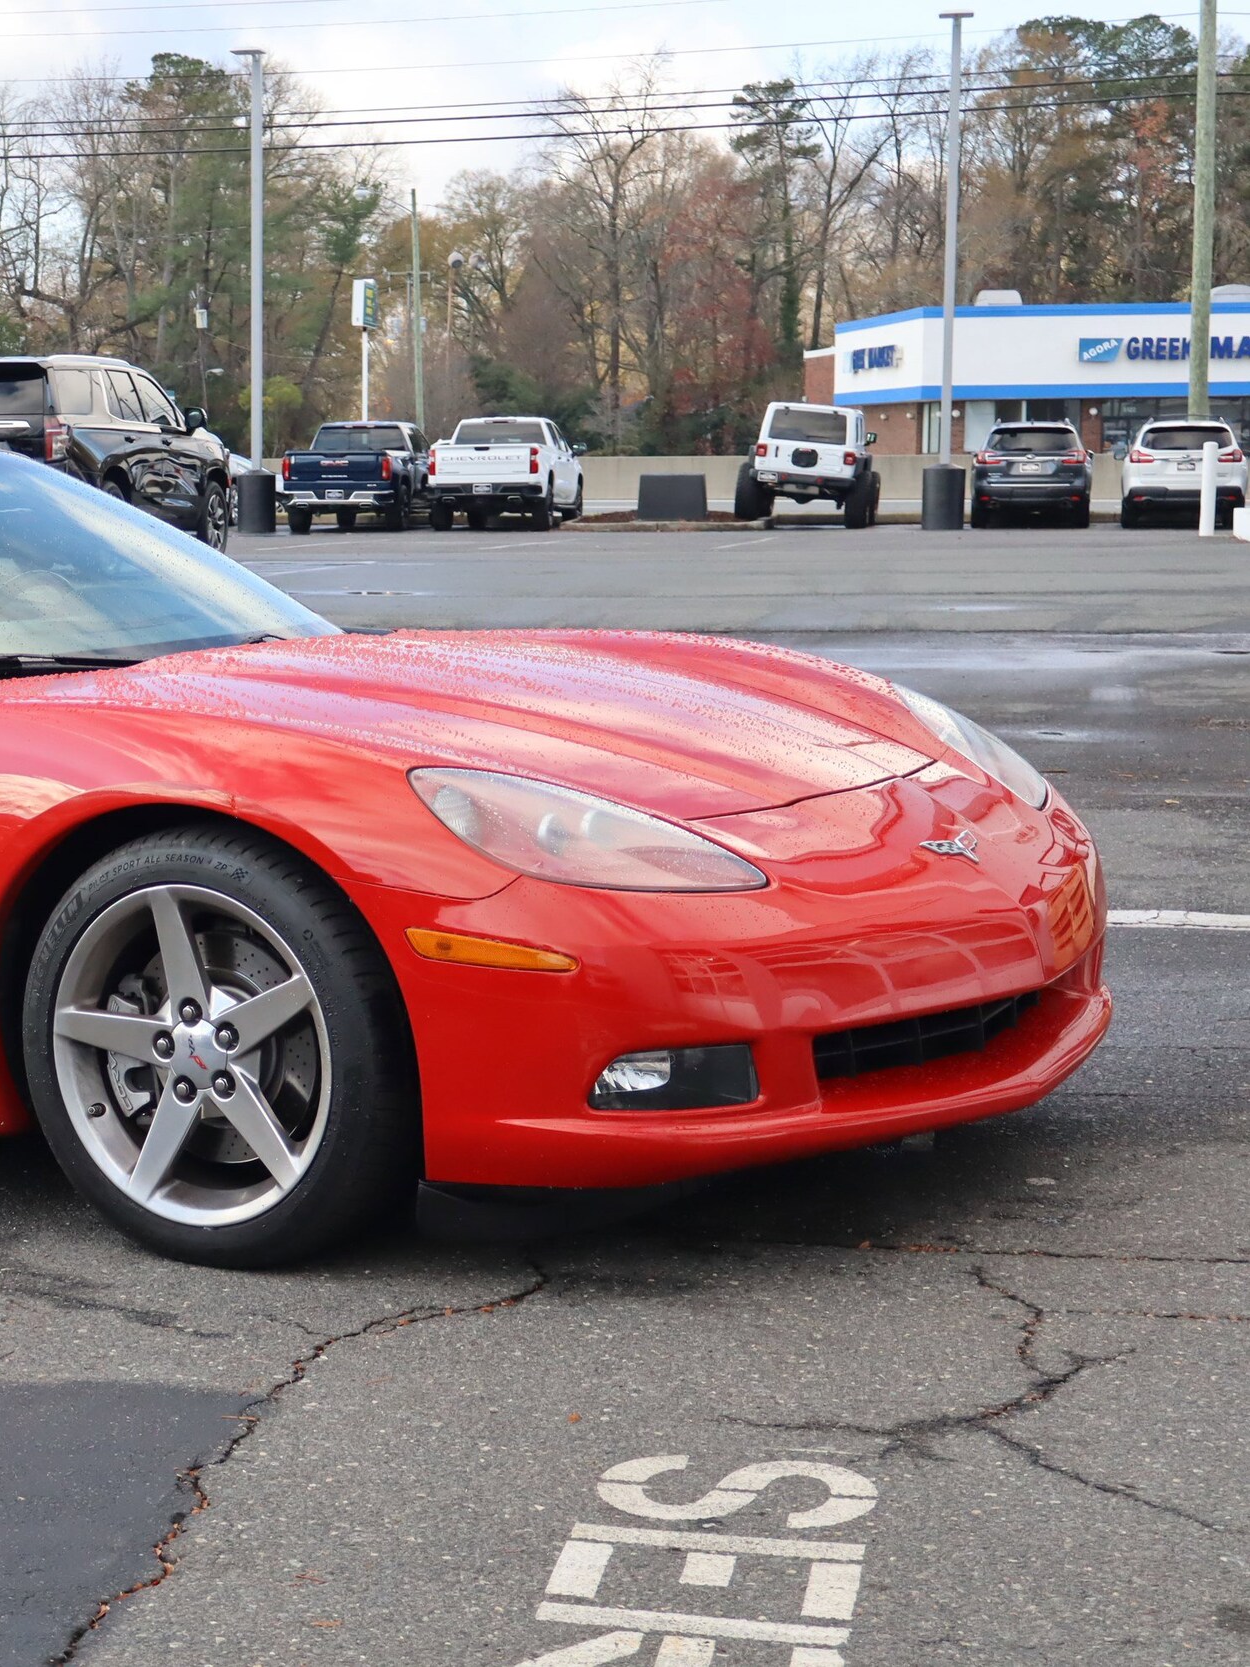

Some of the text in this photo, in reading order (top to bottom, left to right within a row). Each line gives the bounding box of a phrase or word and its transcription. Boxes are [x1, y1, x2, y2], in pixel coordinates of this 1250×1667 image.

[1082, 338, 1119, 361] AGORA
[441, 454, 524, 463] CHEVROLET
[88, 872, 109, 893] PILOT
[113, 858, 141, 877] SPORT
[165, 853, 205, 865] SEASON
